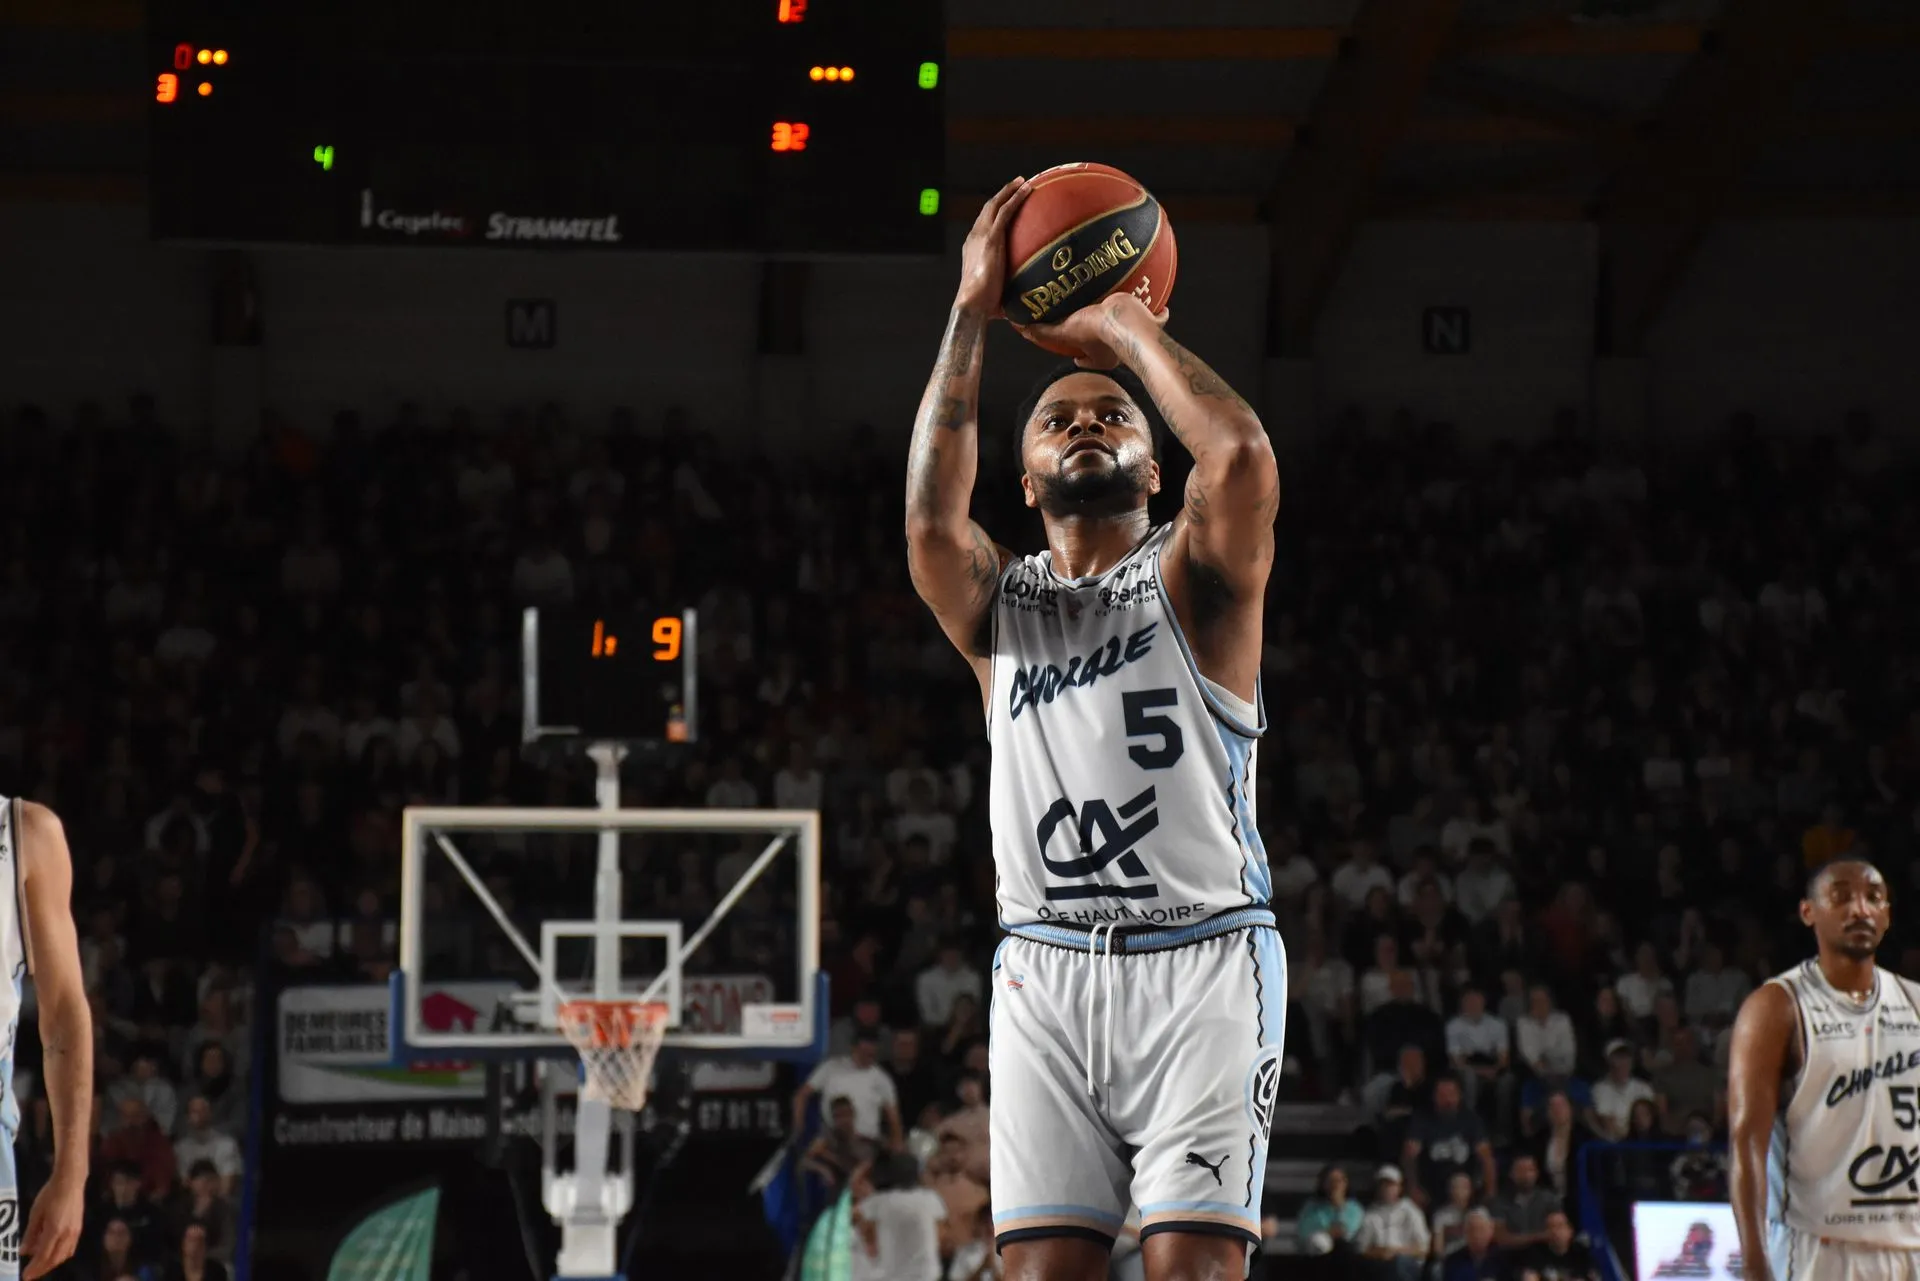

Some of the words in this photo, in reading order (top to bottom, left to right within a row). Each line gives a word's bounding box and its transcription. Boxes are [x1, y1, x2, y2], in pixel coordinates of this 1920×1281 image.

[156, 73, 180, 104] 3
[771, 120, 811, 152] 32
[313, 144, 336, 172] 4
[1020, 227, 1137, 320] SPALDING
[511, 305, 550, 343] M
[1429, 312, 1464, 348] N
[652, 616, 683, 662] 9
[1122, 687, 1185, 771] 5
[1889, 1086, 1920, 1130] 5
